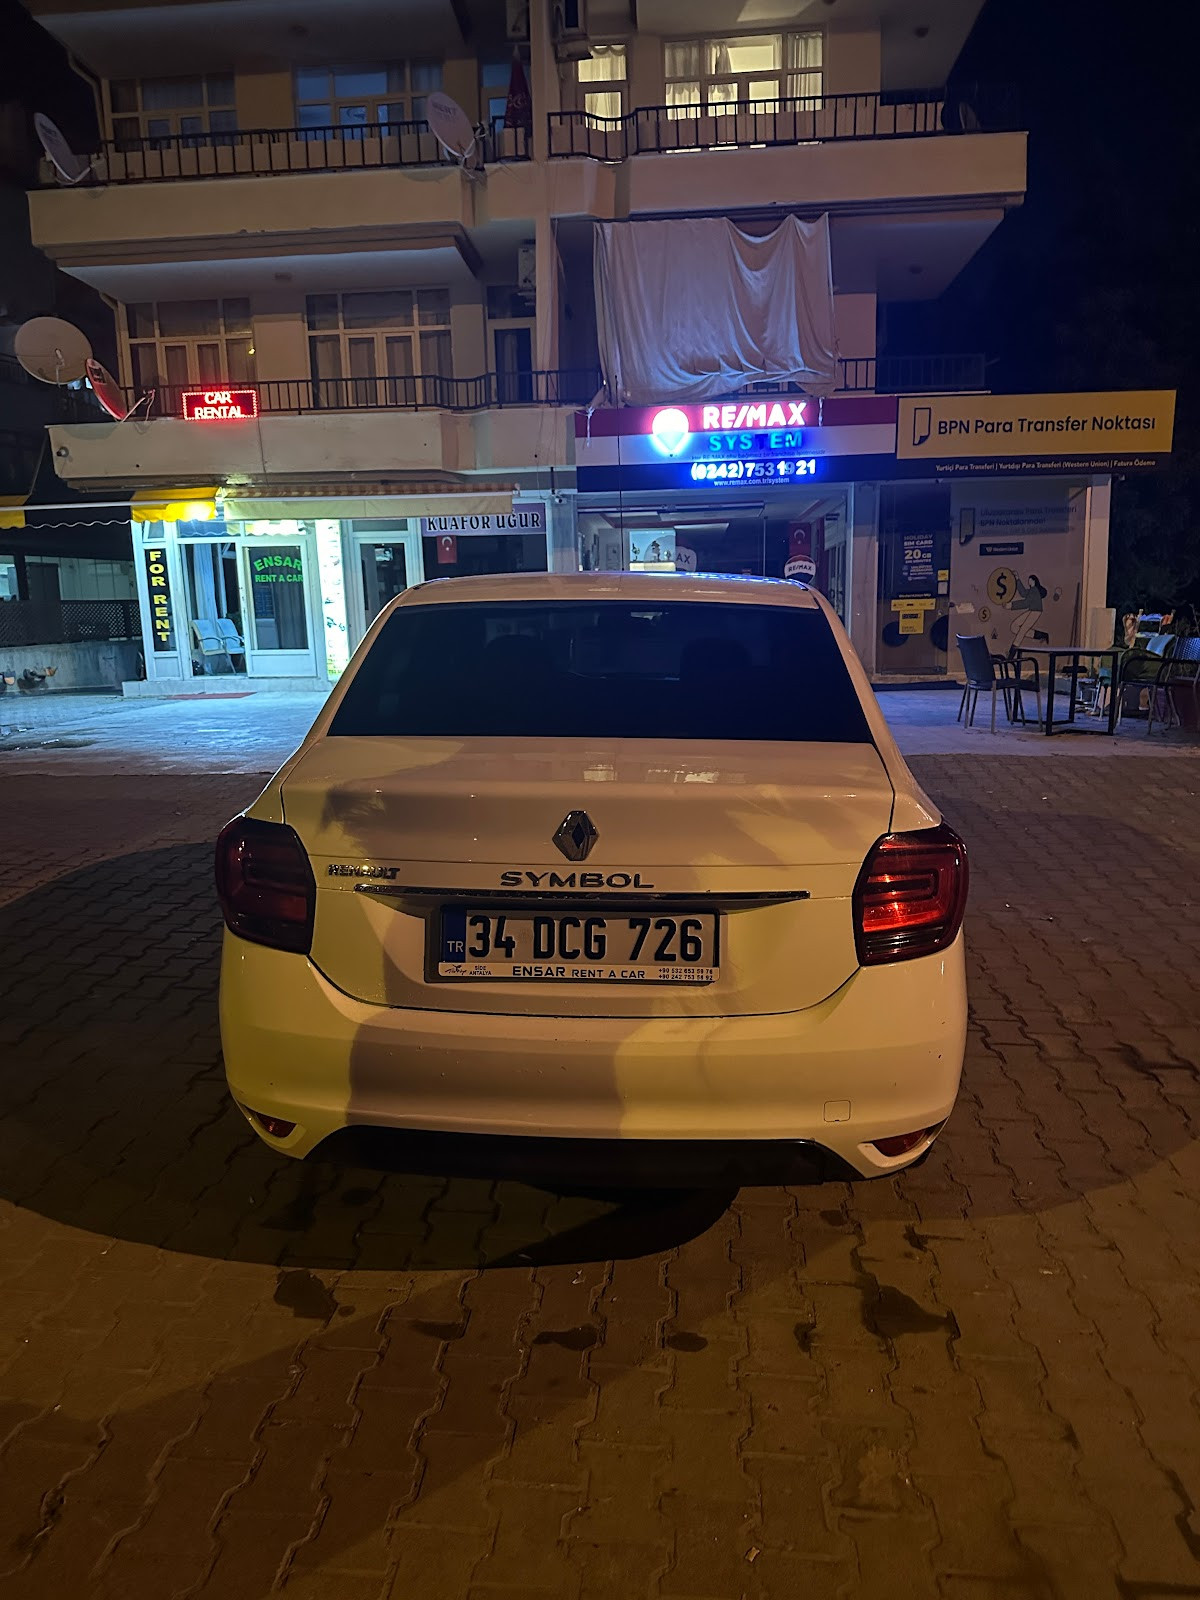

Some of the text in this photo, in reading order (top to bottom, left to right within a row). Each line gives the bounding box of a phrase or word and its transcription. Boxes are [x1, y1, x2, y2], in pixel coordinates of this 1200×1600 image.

[204, 392, 233, 404] CAR
[194, 406, 246, 420] RENTAL
[703, 402, 807, 430] RE/MAX
[938, 415, 1156, 435] BPN Para Transfer Noktası
[708, 431, 804, 452] SYSTEM
[955, 463, 969, 471] Para
[969, 463, 995, 471] Transferi
[1036, 461, 1061, 470] Transferi
[904, 549, 922, 560] 20
[149, 551, 166, 587] FOR
[253, 555, 302, 572] ENSAR
[788, 564, 812, 572] RE/MAX
[255, 574, 304, 583] RENT A CAR
[153, 594, 170, 642] RENT
[328, 864, 400, 880] RENAULT
[500, 871, 655, 889] SYMBOL
[468, 915, 703, 961] 34 DCG 726
[446, 940, 464, 953] TR
[512, 965, 646, 979] ENSAR RENT A CAR
